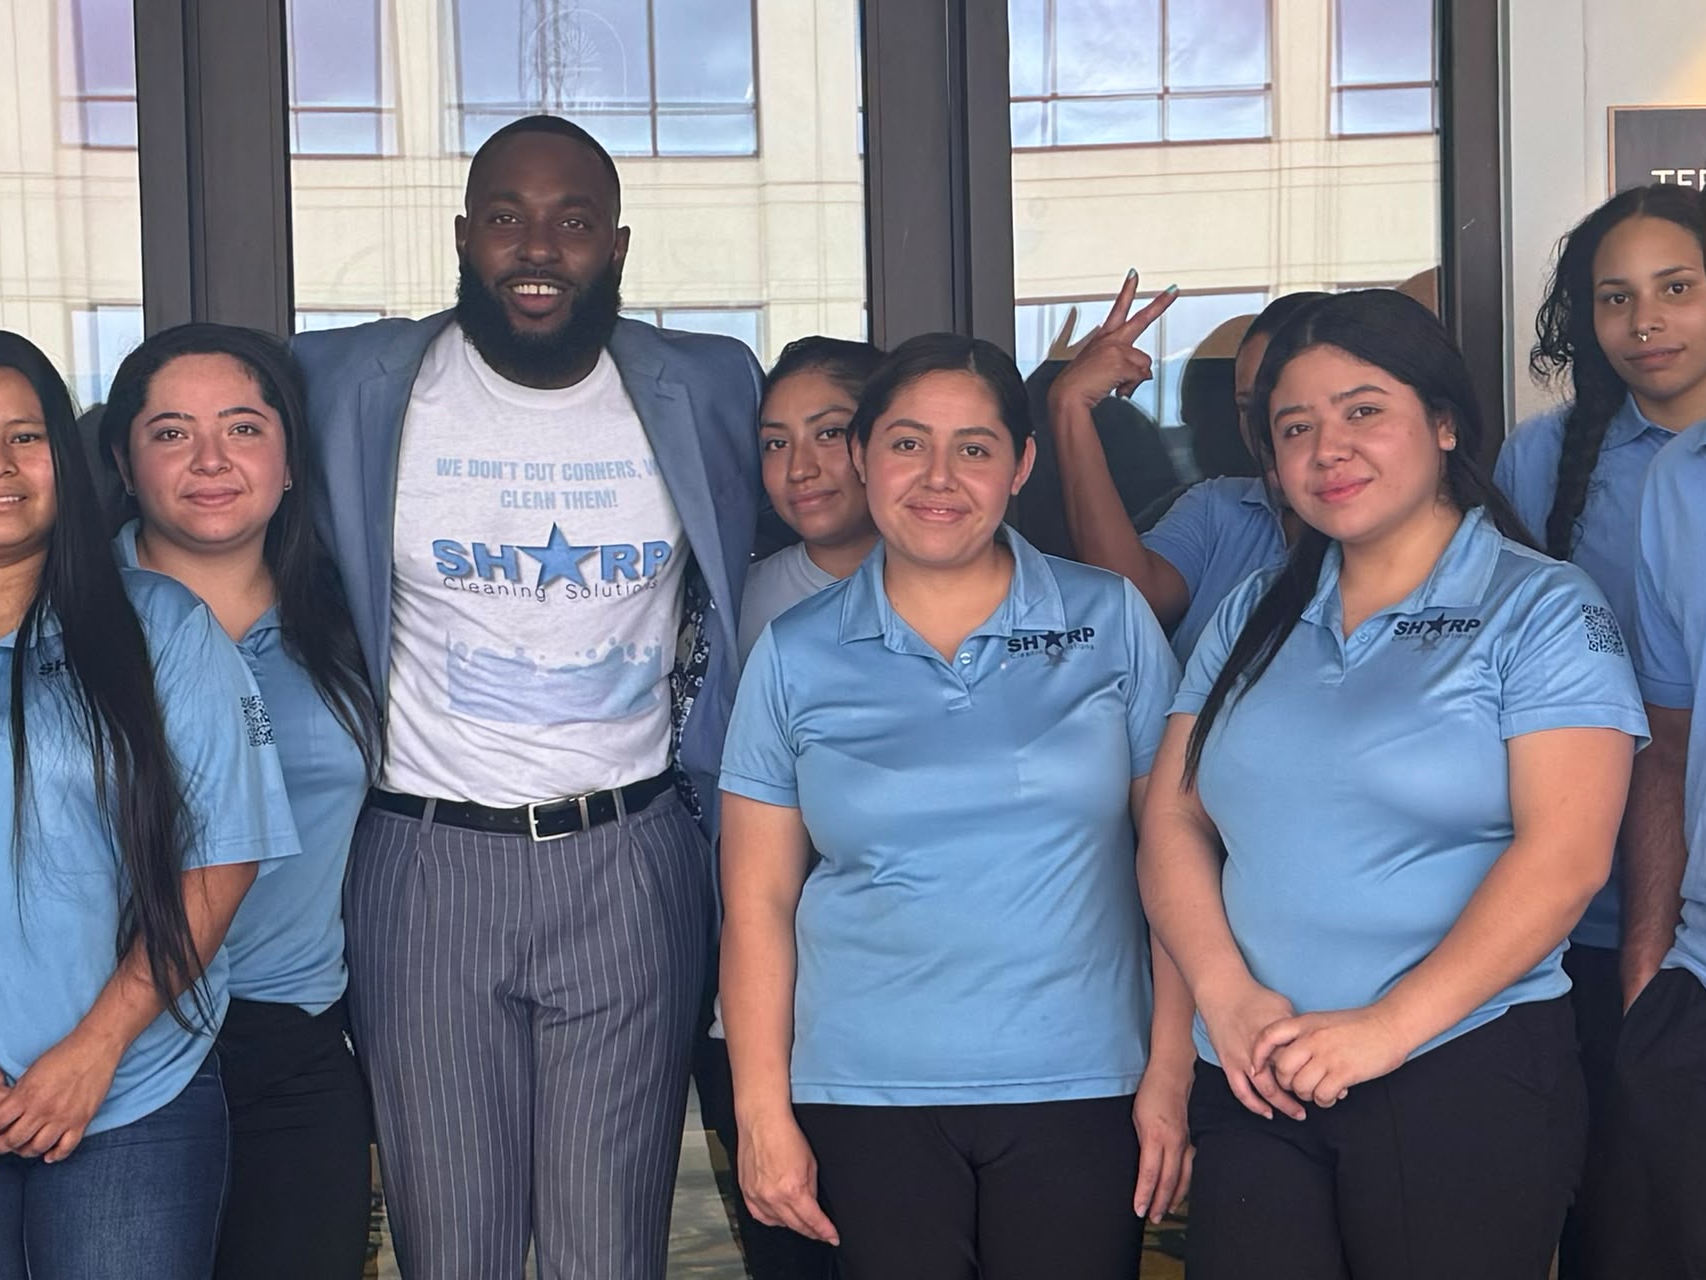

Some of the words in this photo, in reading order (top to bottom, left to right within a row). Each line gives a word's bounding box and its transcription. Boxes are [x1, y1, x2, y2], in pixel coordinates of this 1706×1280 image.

[436, 458, 462, 477] WE
[468, 459, 518, 480] DON'T
[524, 462, 556, 481] CUT
[561, 460, 643, 481] CORNERS,
[500, 489, 556, 510] CLEAN
[562, 489, 619, 510] THEM!
[443, 576, 546, 602] Cleaning
